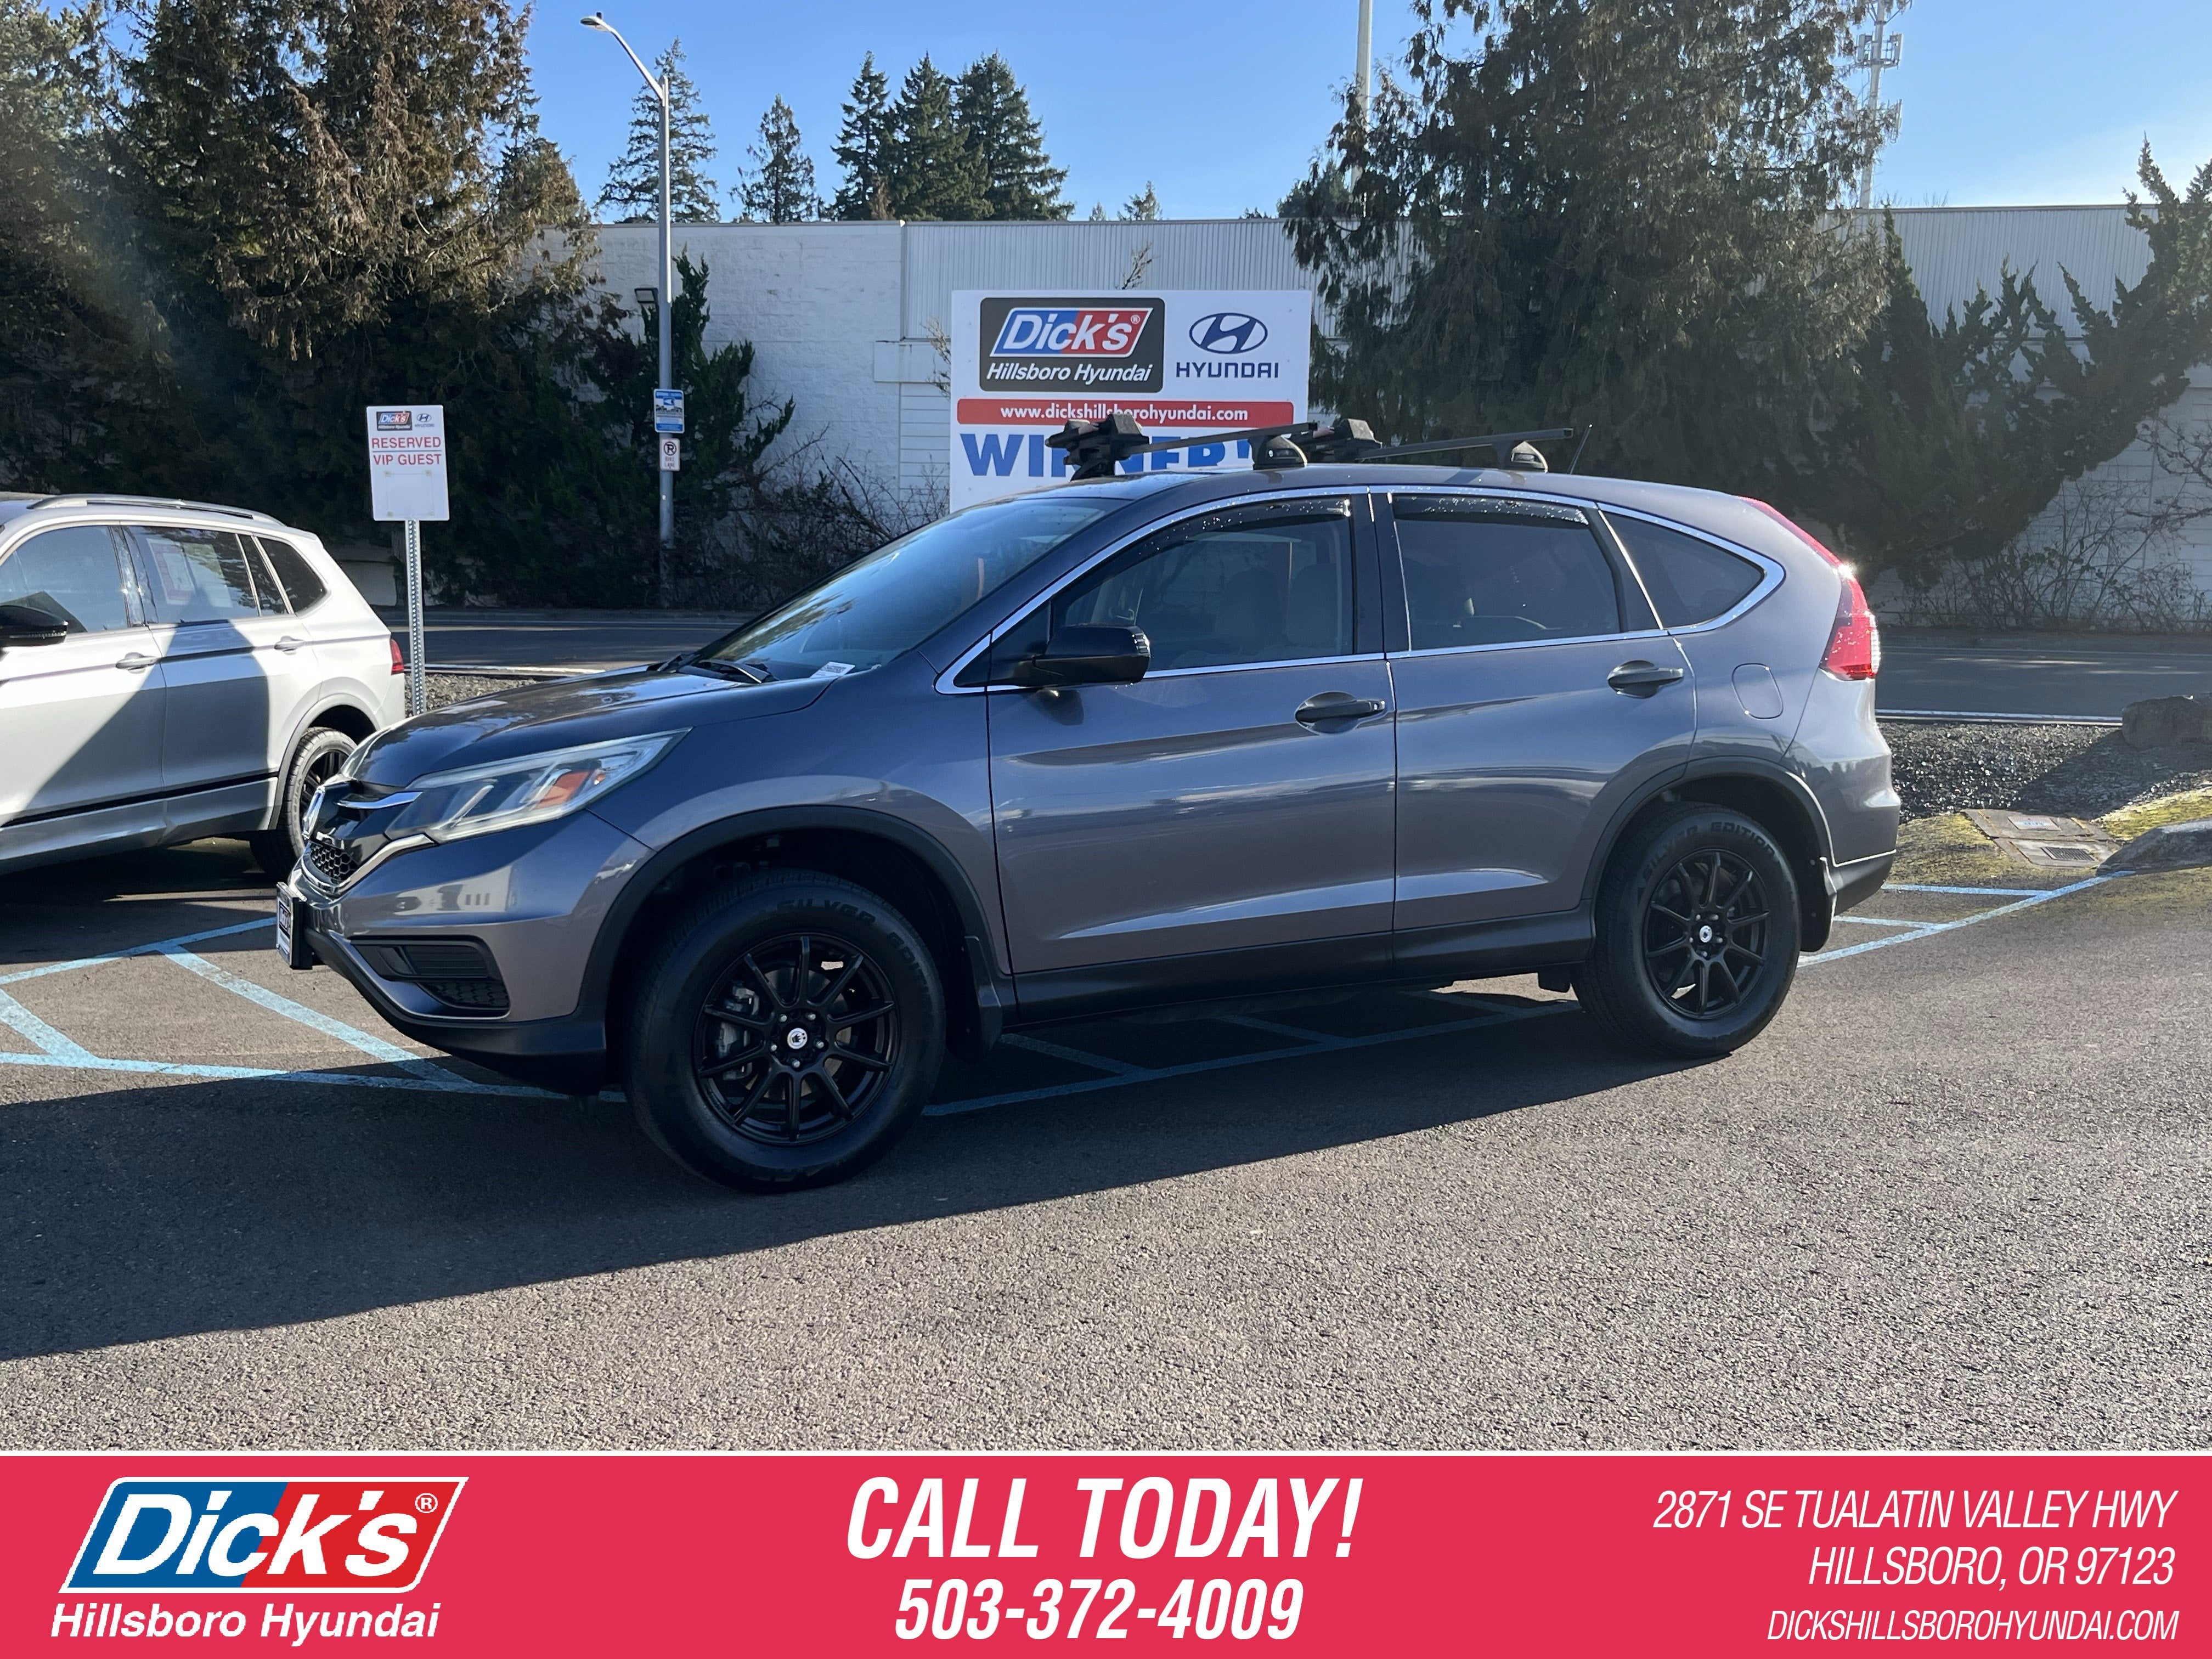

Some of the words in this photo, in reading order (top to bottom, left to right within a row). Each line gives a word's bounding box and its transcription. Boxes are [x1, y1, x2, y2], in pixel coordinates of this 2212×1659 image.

[986, 363, 1070, 381] Hillsboro
[1074, 363, 1153, 385] Hyundai
[1176, 362, 1279, 379] HYUNDAI
[371, 437, 441, 449] RESERVED
[373, 454, 393, 465] VIP
[398, 454, 442, 465] GUEST
